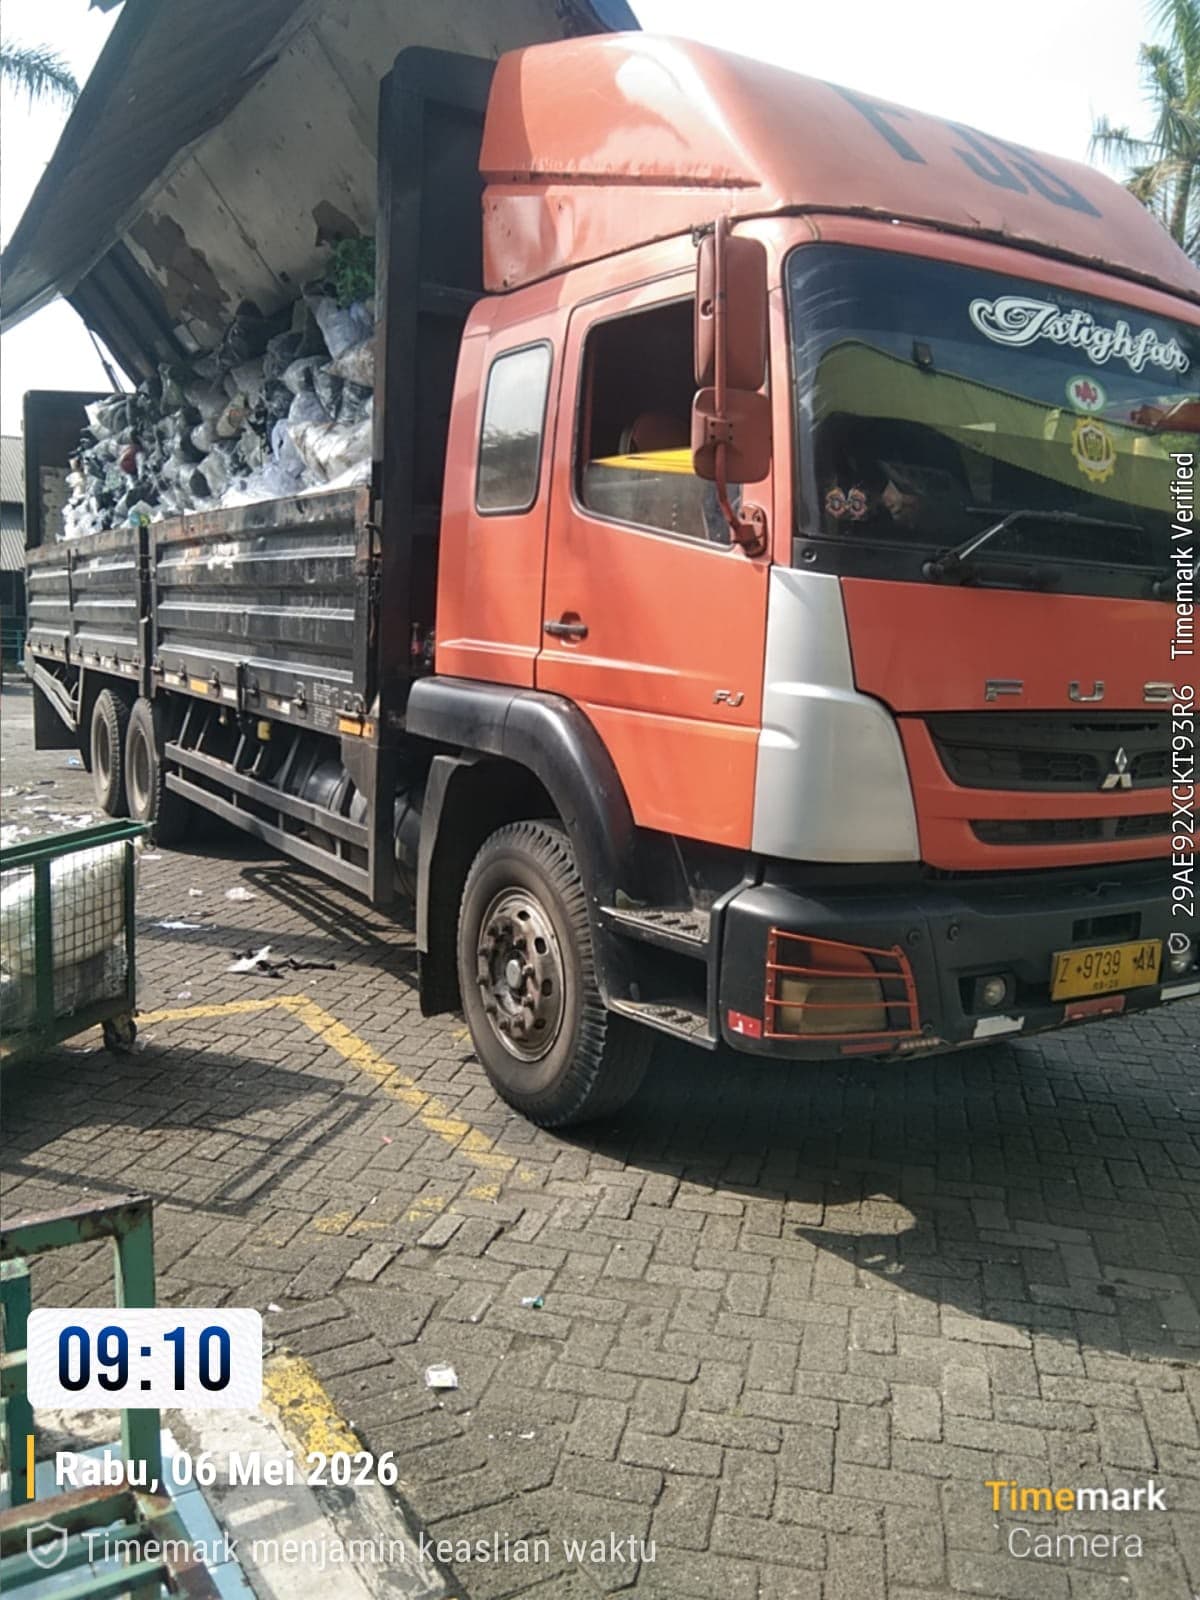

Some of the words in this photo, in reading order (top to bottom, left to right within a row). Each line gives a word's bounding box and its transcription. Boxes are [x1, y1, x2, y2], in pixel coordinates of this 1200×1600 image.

[969, 296, 1190, 373] Istighfar
[712, 689, 745, 707] FJ
[1059, 957, 1071, 983] Z
[1083, 949, 1122, 979] 9739
